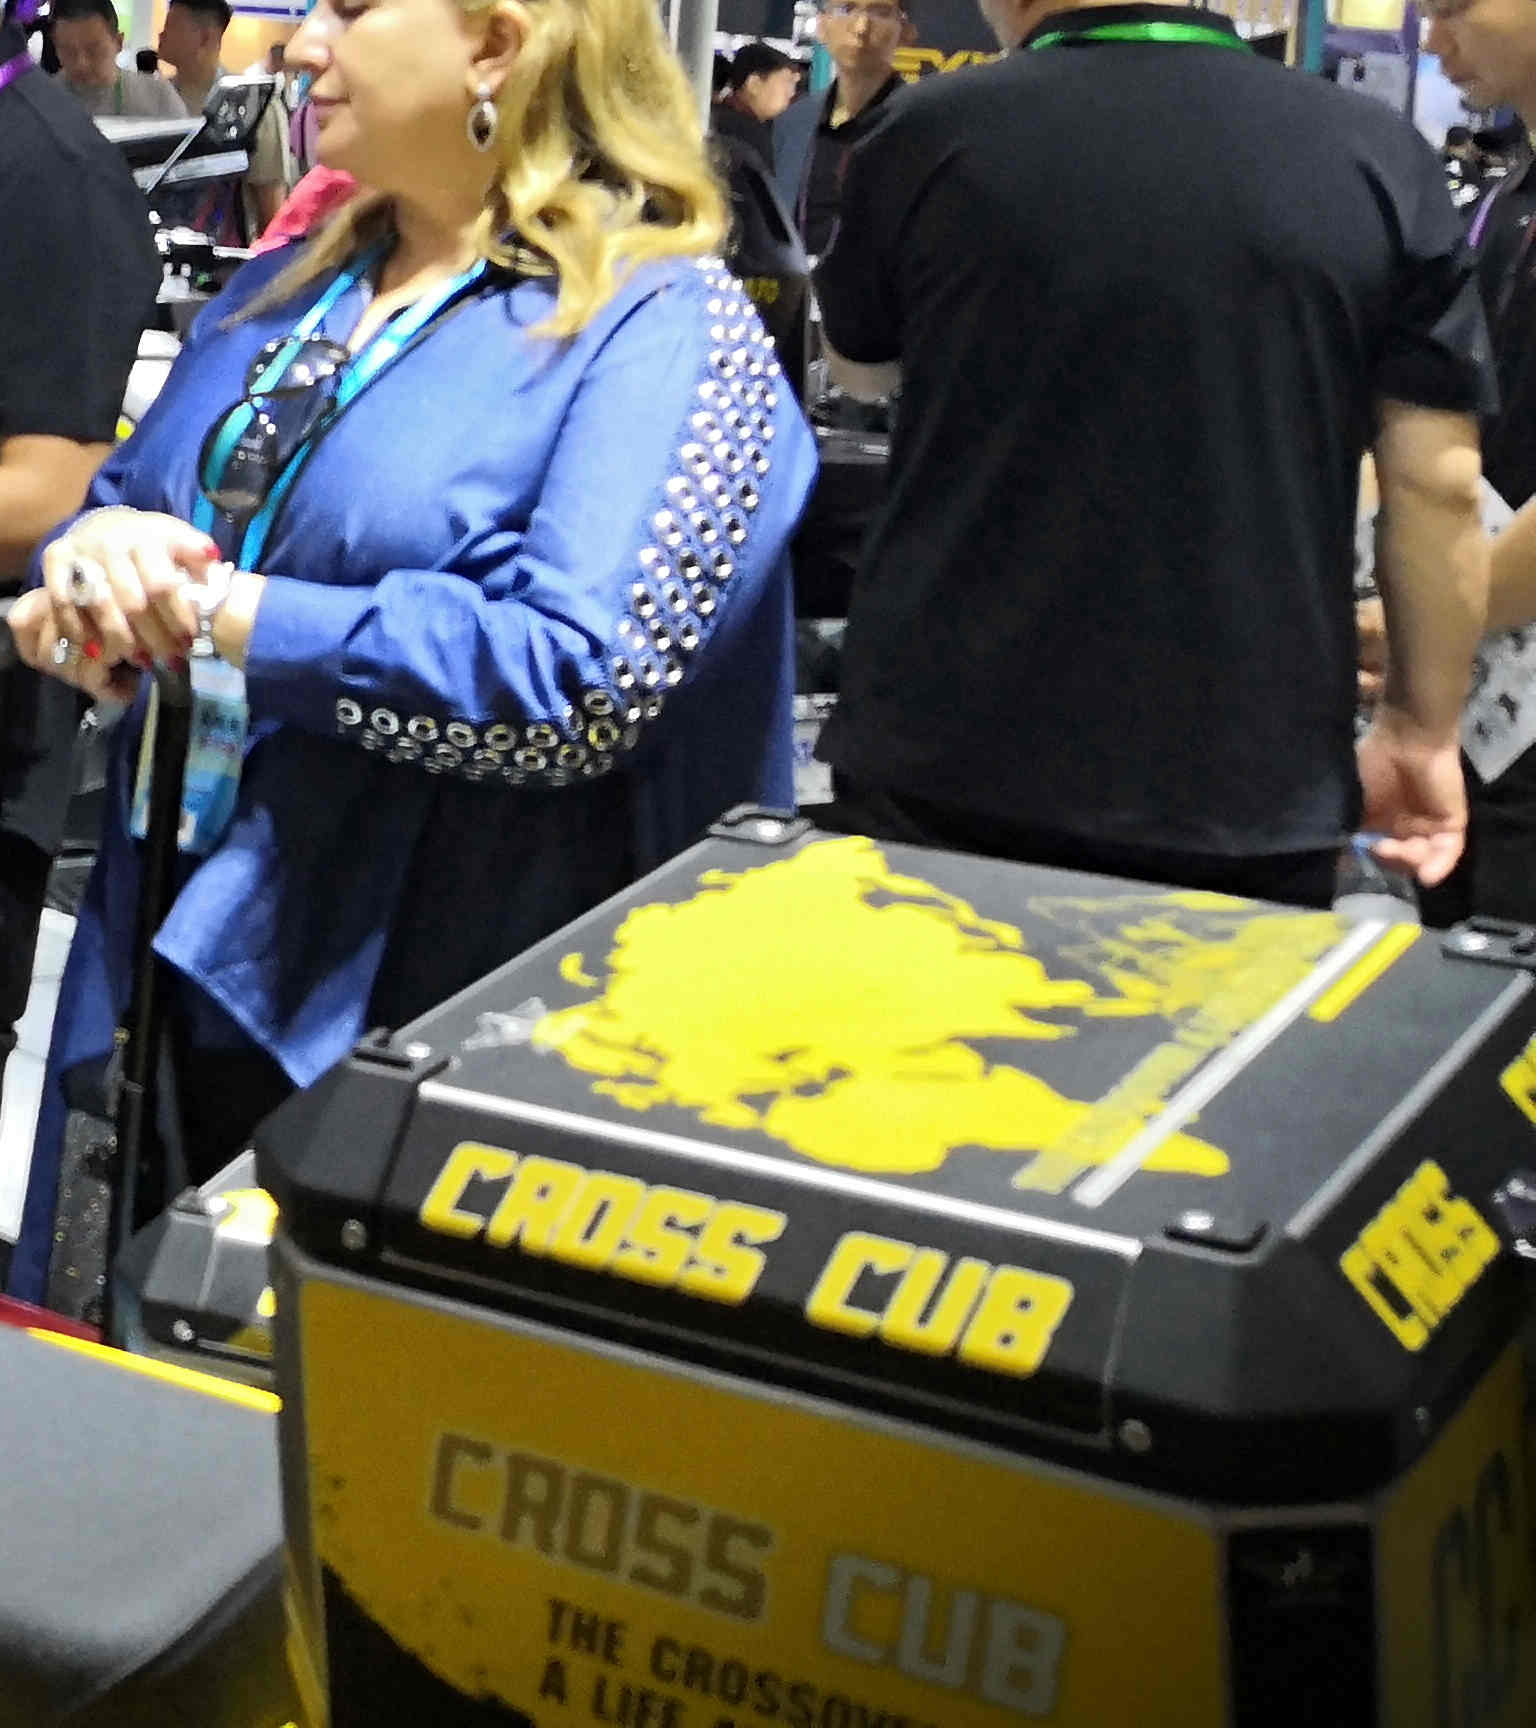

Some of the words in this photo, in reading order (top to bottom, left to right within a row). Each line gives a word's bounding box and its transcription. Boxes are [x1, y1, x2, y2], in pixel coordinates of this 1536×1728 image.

[419, 1139, 788, 1307] CROSS
[805, 1232, 1075, 1378] CUB
[430, 1432, 785, 1624] CROSS
[823, 1553, 1070, 1716] CUB
[546, 1597, 627, 1667] THE
